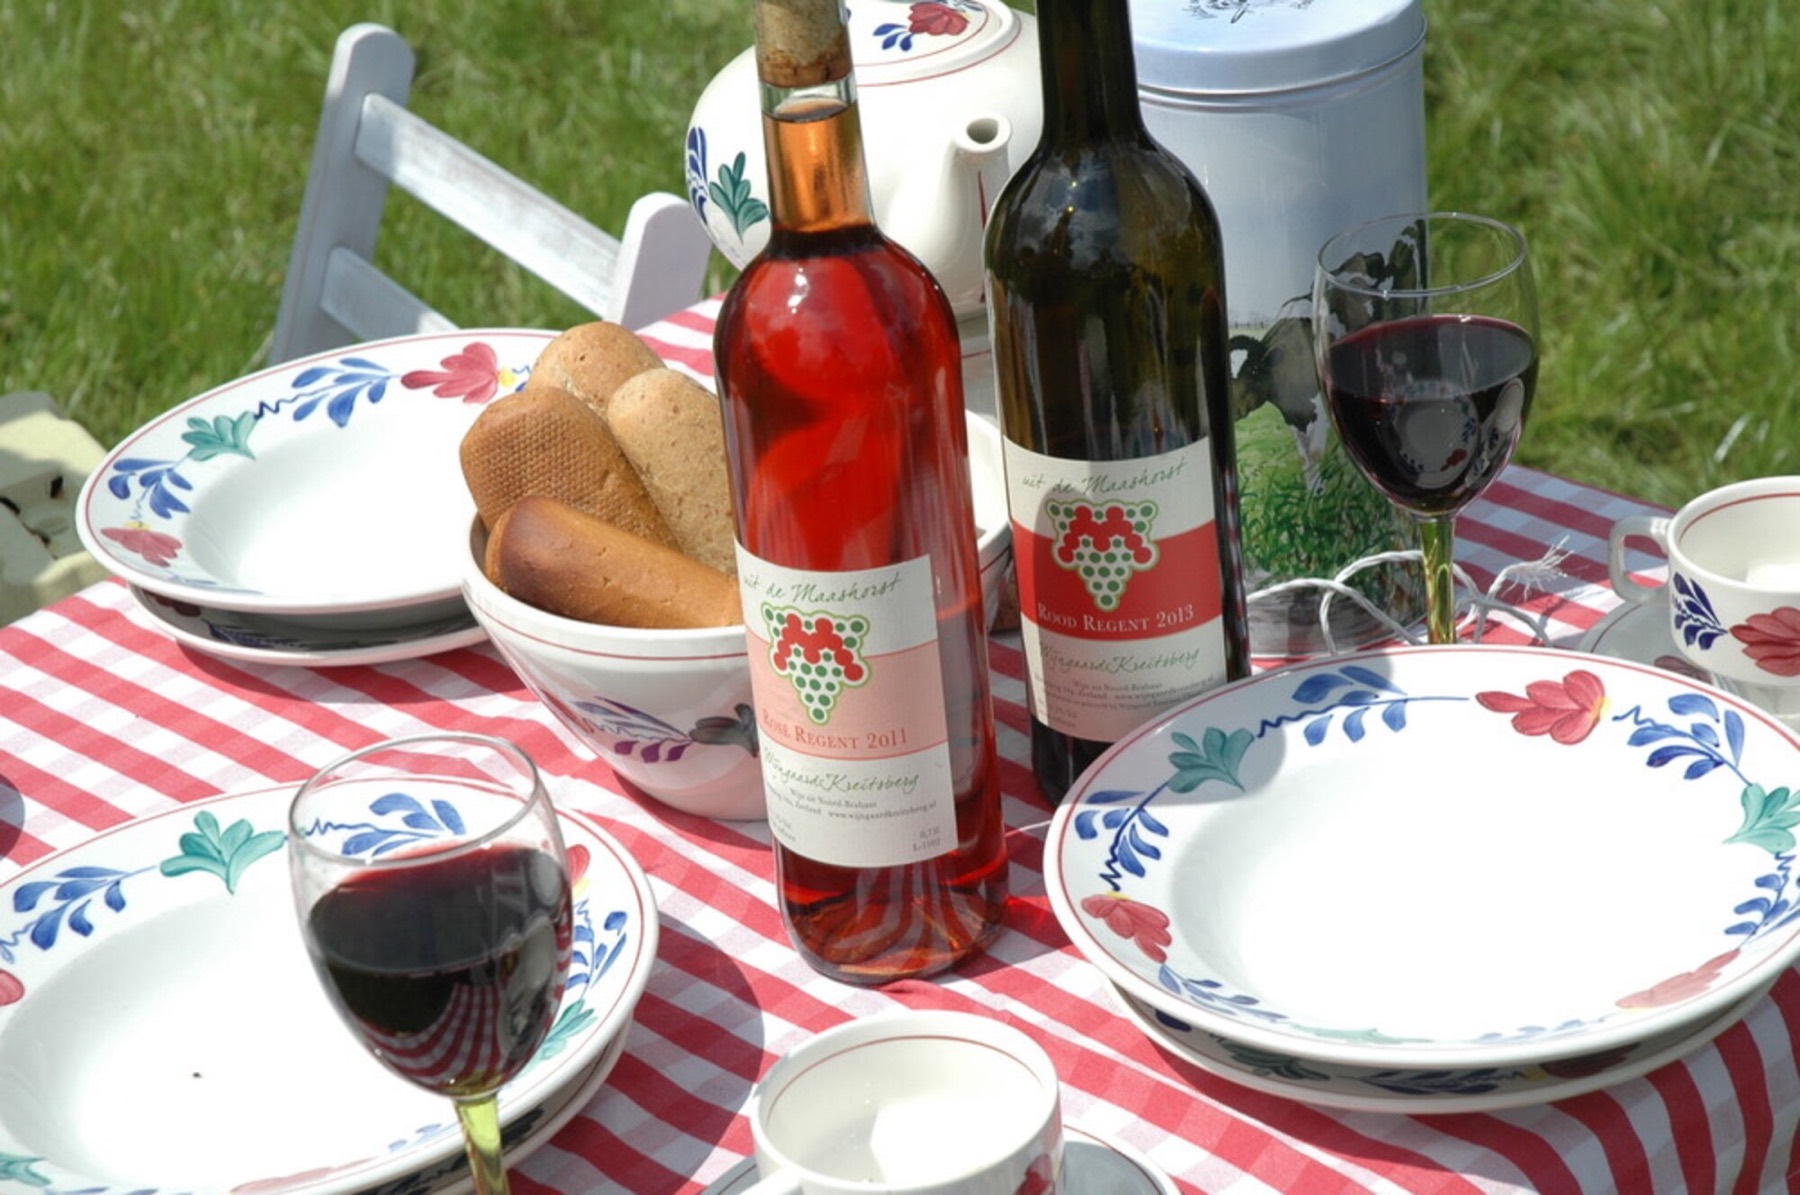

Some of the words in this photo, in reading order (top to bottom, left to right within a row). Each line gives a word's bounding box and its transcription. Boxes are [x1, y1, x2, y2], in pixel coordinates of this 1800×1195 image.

[1083, 614, 1150, 633] REGENT
[1156, 603, 1195, 629] 2013
[795, 725, 859, 750] REGENT
[866, 726, 907, 749] 2011
